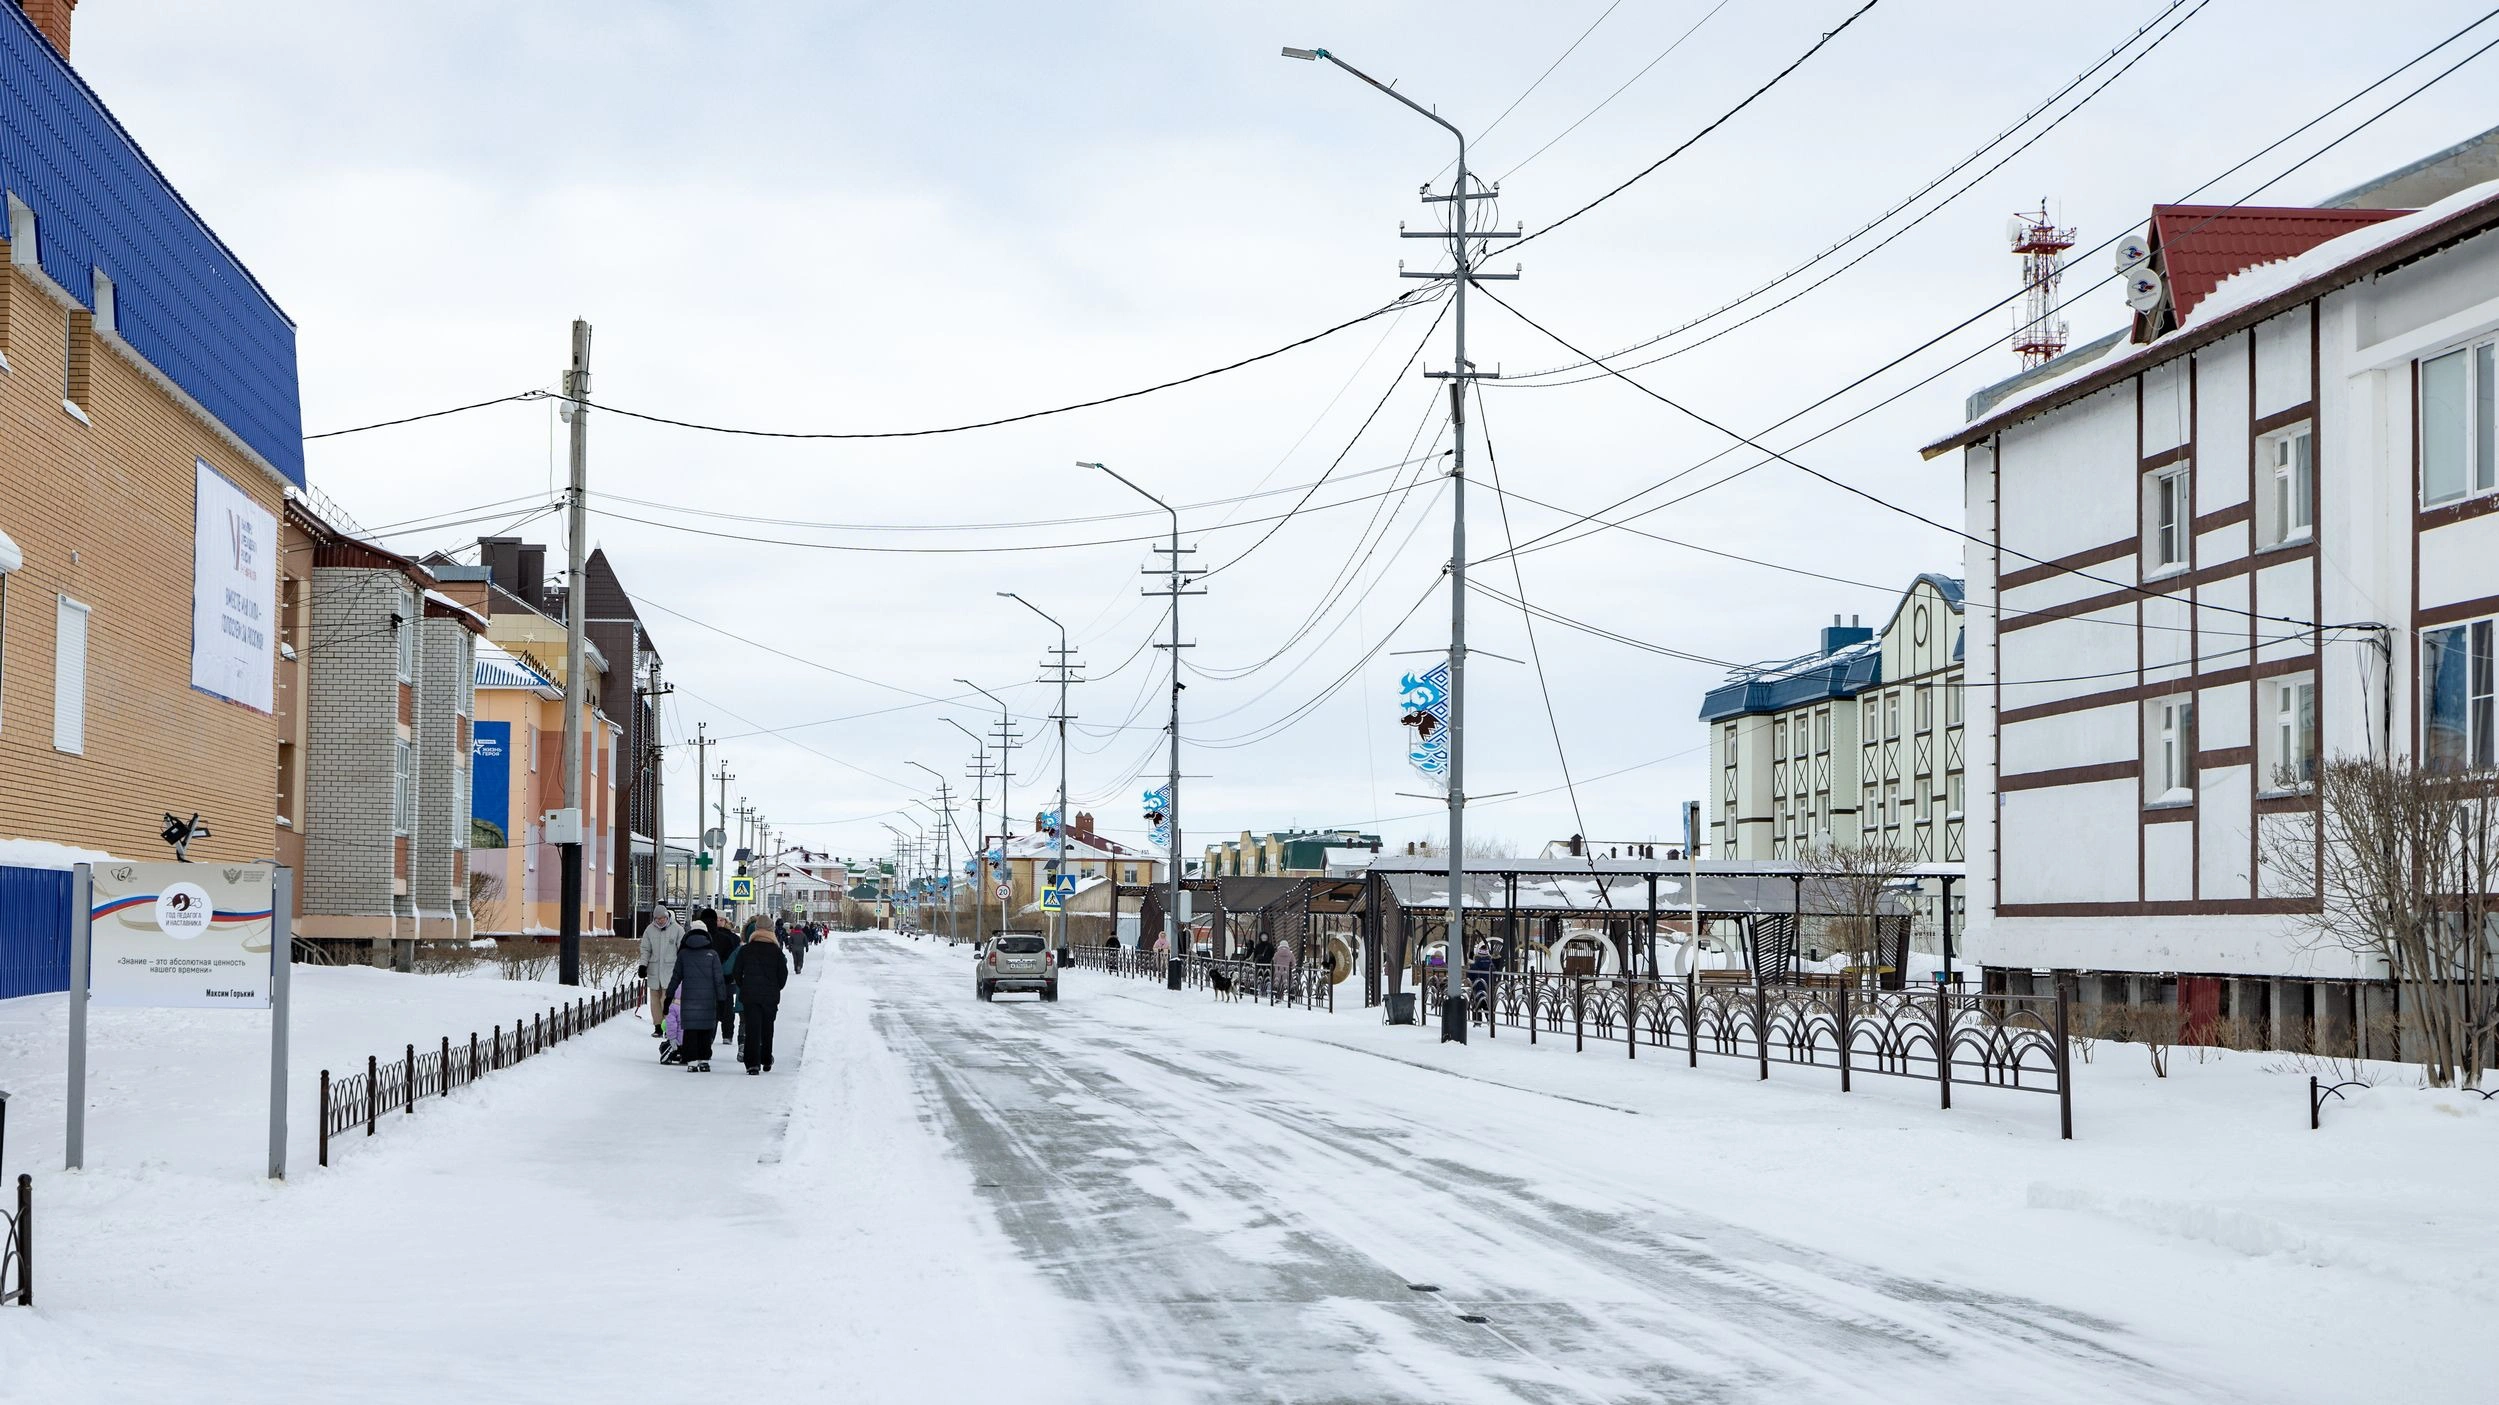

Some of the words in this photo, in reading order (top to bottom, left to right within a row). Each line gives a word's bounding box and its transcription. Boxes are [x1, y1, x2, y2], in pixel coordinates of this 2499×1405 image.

[999, 888, 1008, 896] 20
[117, 957, 147, 965] «Знание
[169, 957, 212, 966] абсолютная
[213, 959, 246, 967] ценность
[150, 966, 177, 974] нашего
[178, 966, 213, 974] времени»
[206, 989, 229, 998] Максим
[230, 989, 255, 999] Горький
